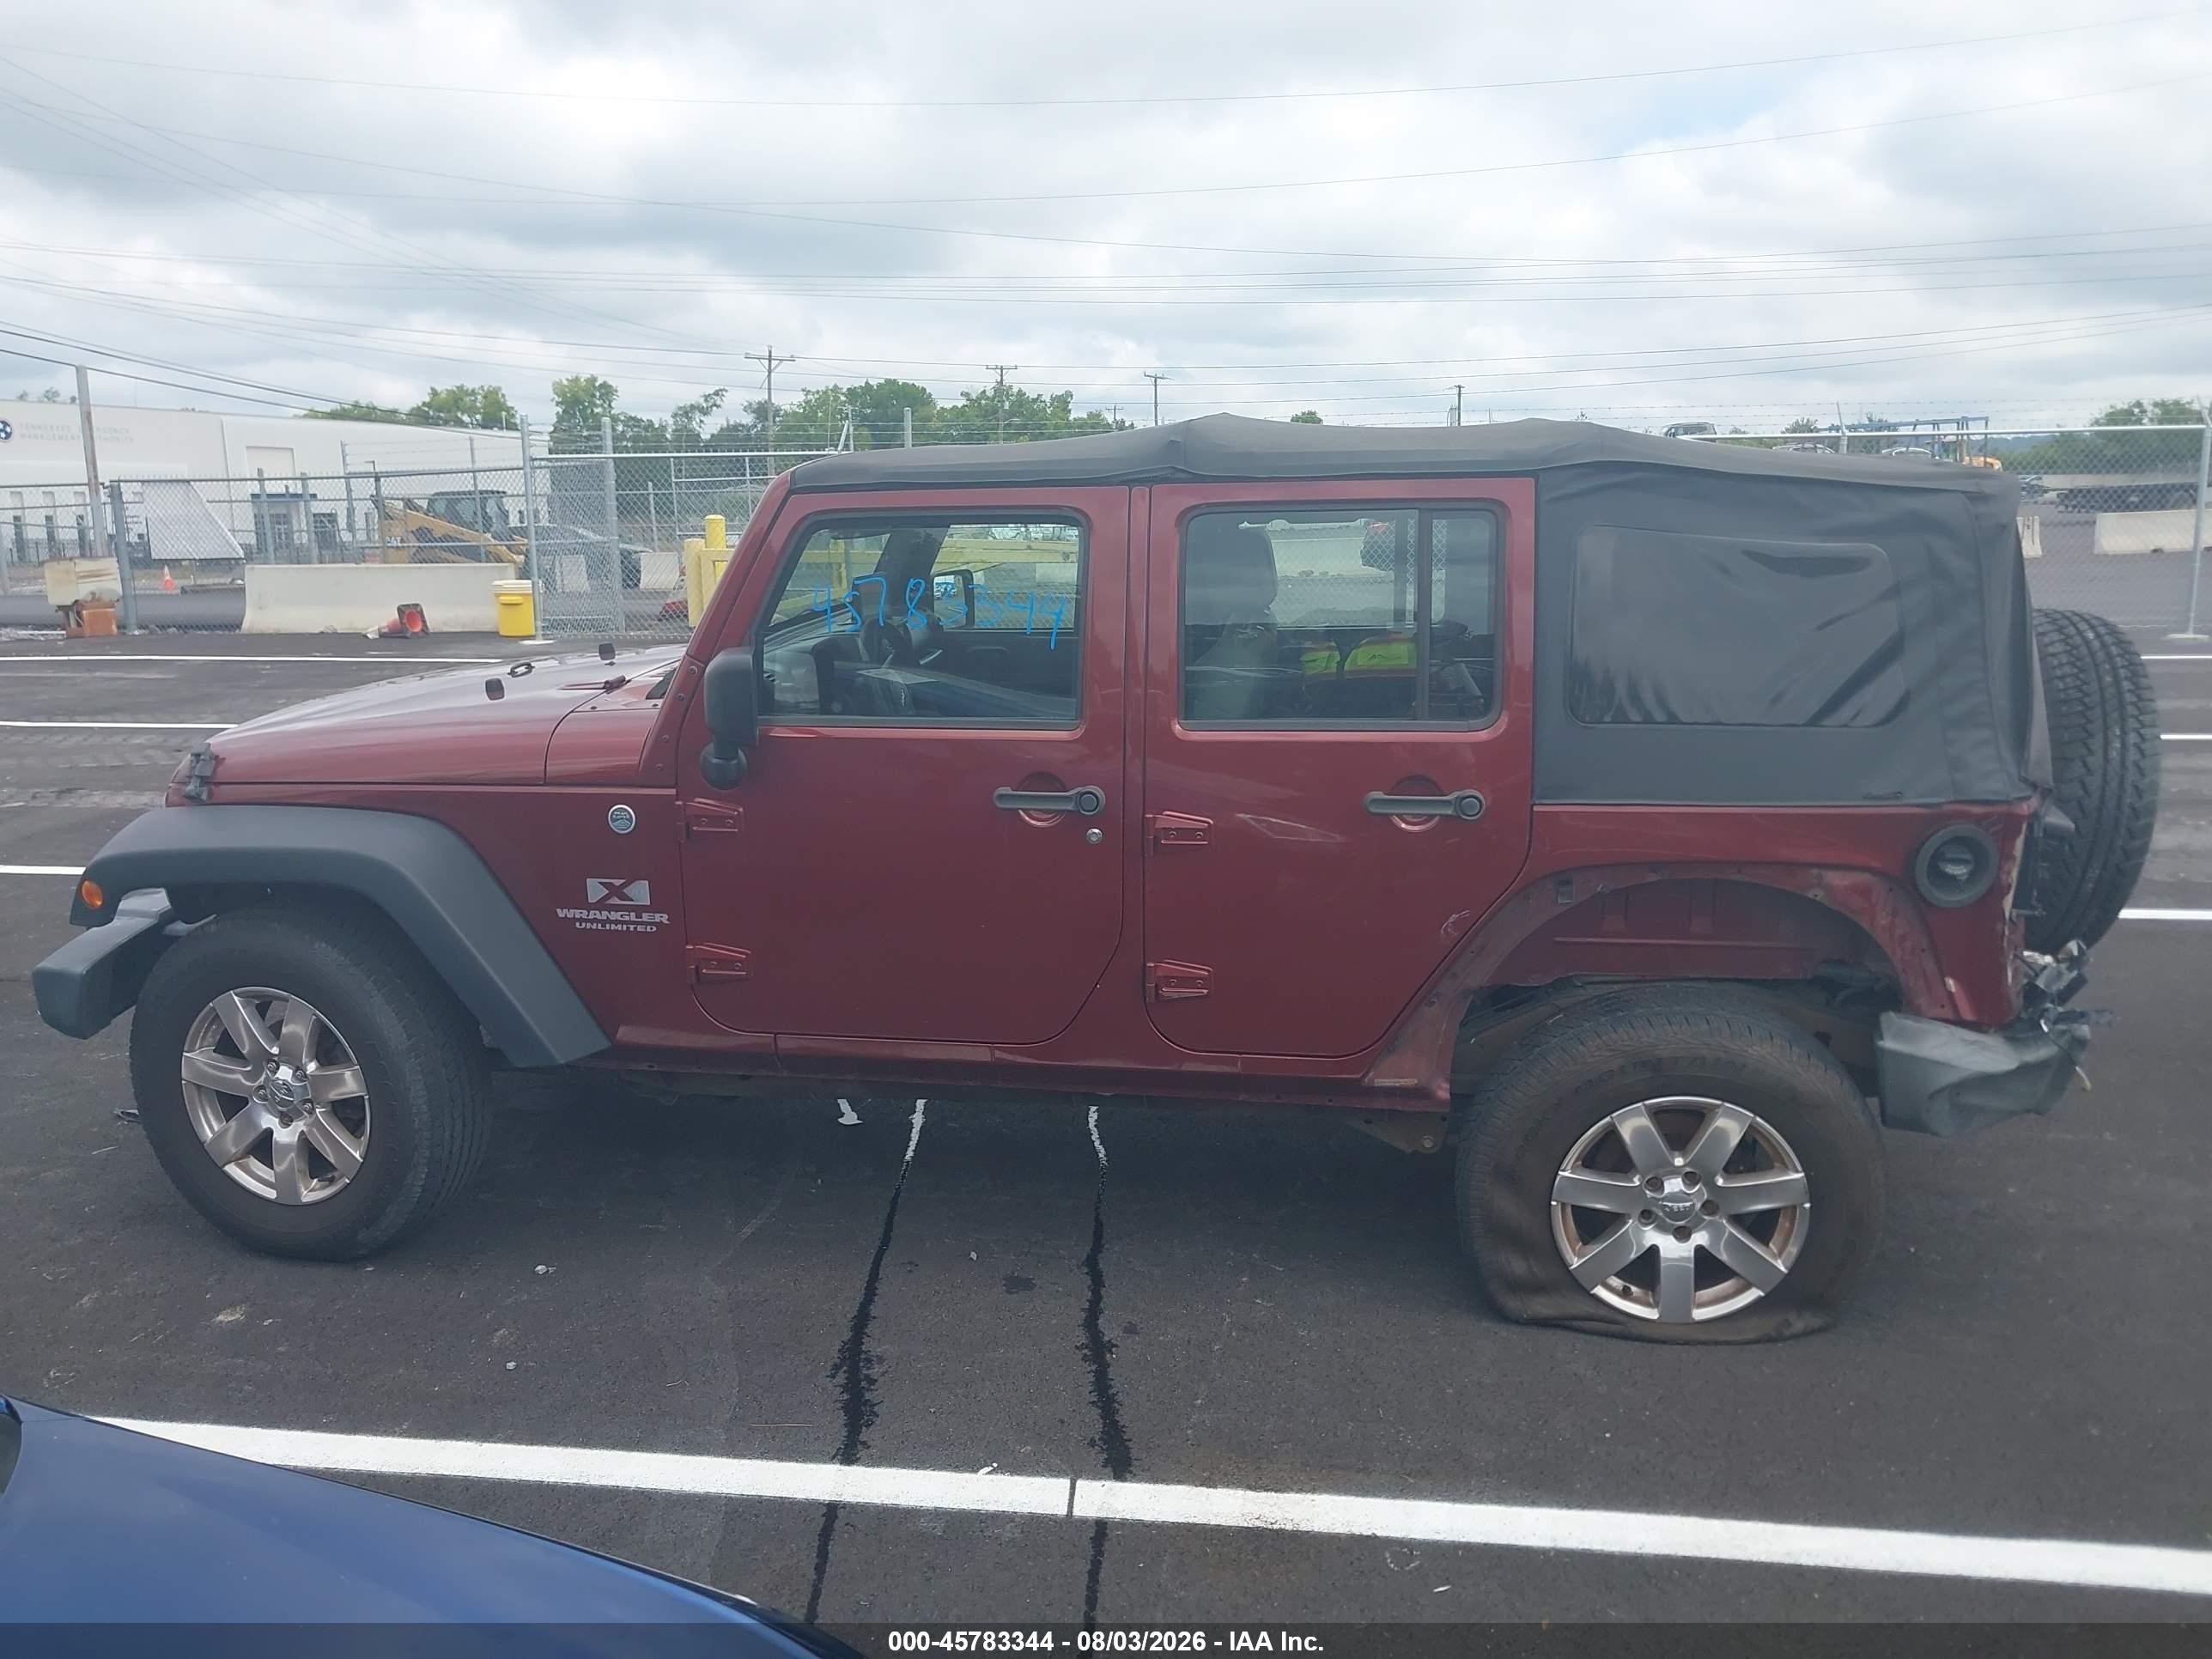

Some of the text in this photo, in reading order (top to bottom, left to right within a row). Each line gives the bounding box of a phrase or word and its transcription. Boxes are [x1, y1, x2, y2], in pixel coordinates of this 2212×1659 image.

[810, 576, 1068, 651] 45783344
[556, 908, 672, 924] WRANGLER
[575, 921, 658, 933] UNLIMITED
